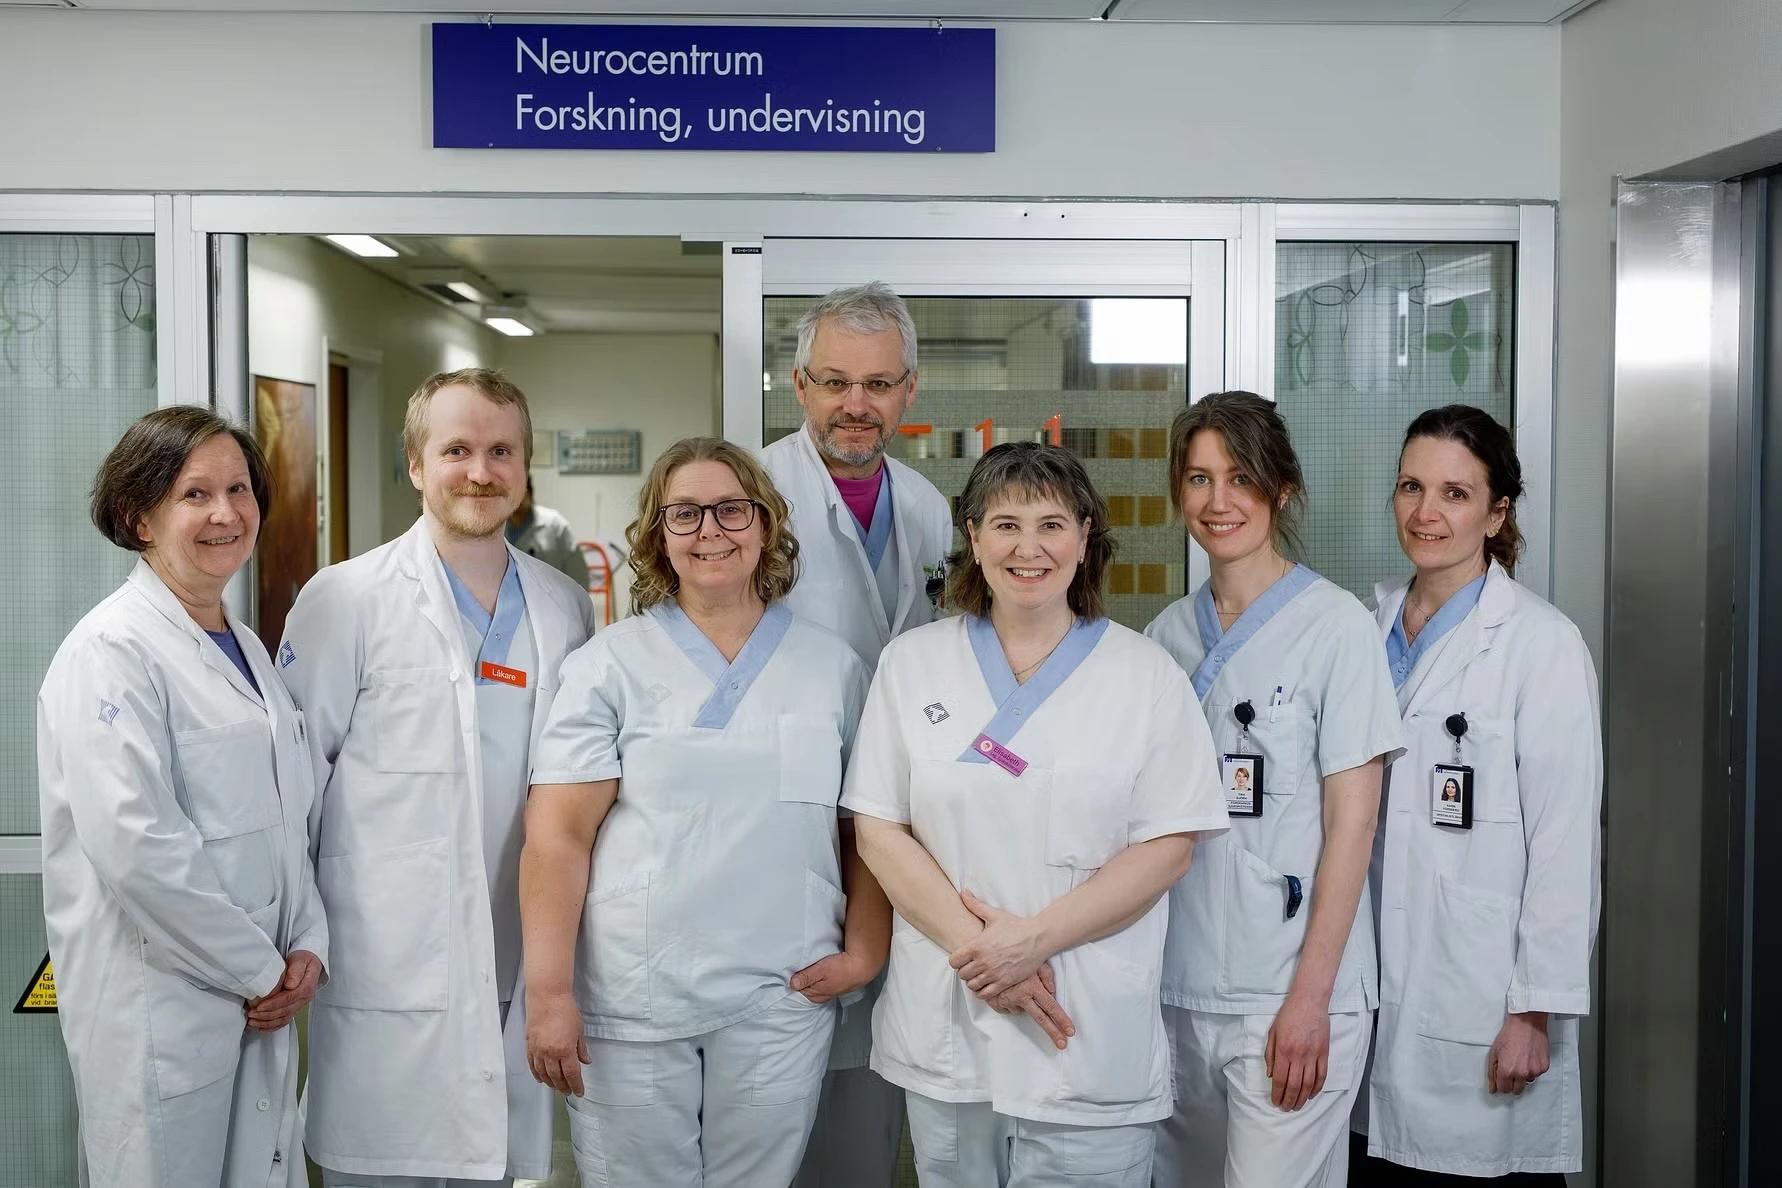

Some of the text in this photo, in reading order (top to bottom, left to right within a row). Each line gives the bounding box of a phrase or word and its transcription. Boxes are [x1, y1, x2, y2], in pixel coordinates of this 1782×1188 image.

[516, 36, 764, 76] Neurocentrum
[516, 91, 925, 145] Forskning, undervisning
[492, 668, 516, 681] Läkare
[993, 746, 1020, 767] Elisabeth
